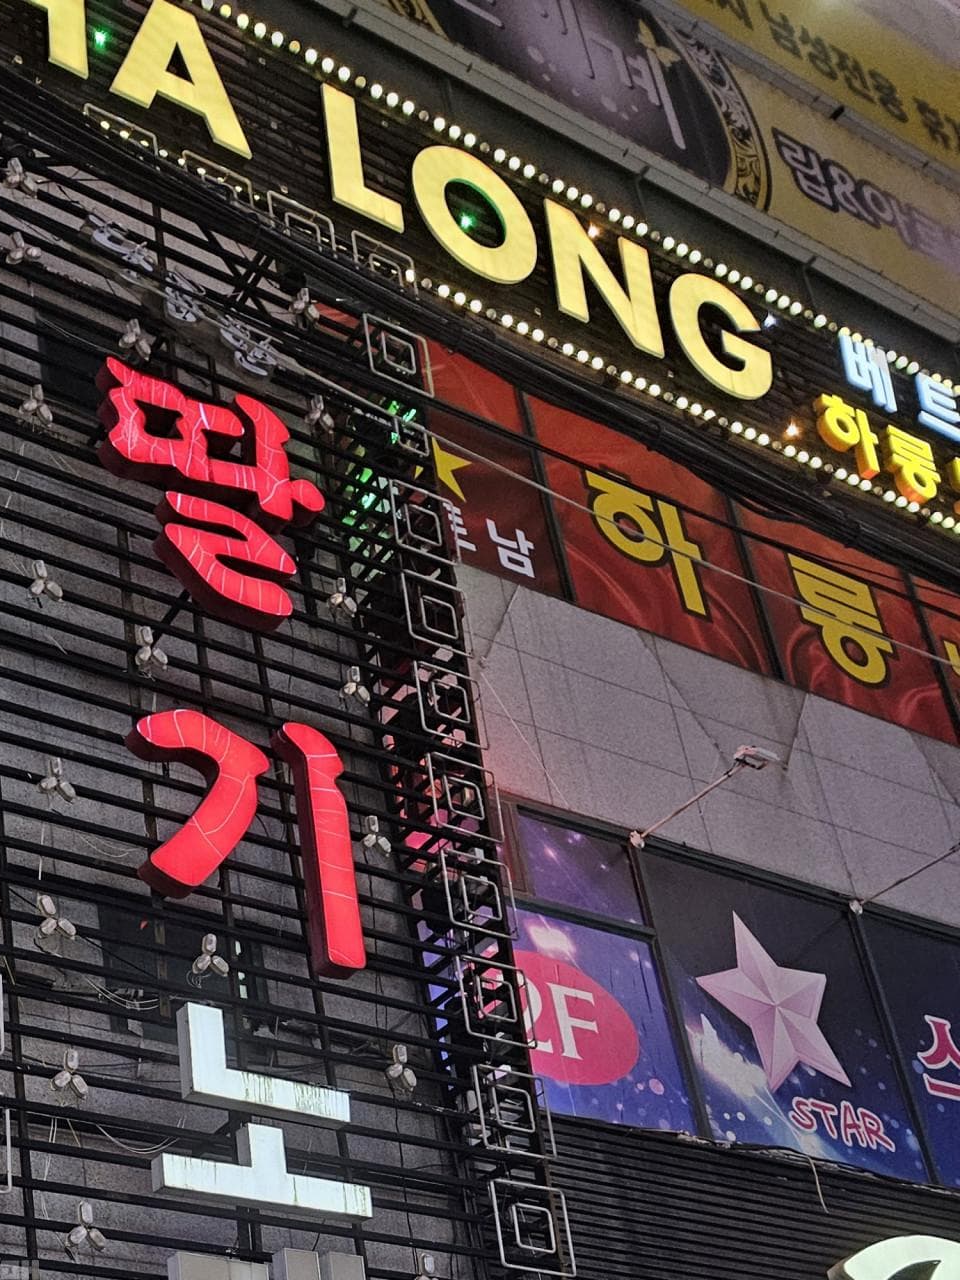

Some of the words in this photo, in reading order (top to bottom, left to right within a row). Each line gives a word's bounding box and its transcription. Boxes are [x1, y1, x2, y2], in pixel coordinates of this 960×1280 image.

[321, 82, 775, 400] LONG
[812, 392, 960, 512] 하롱
[104, 355, 367, 971] 딸기
[584, 467, 960, 686] 하롱
[791, 1097, 897, 1153] STAR
